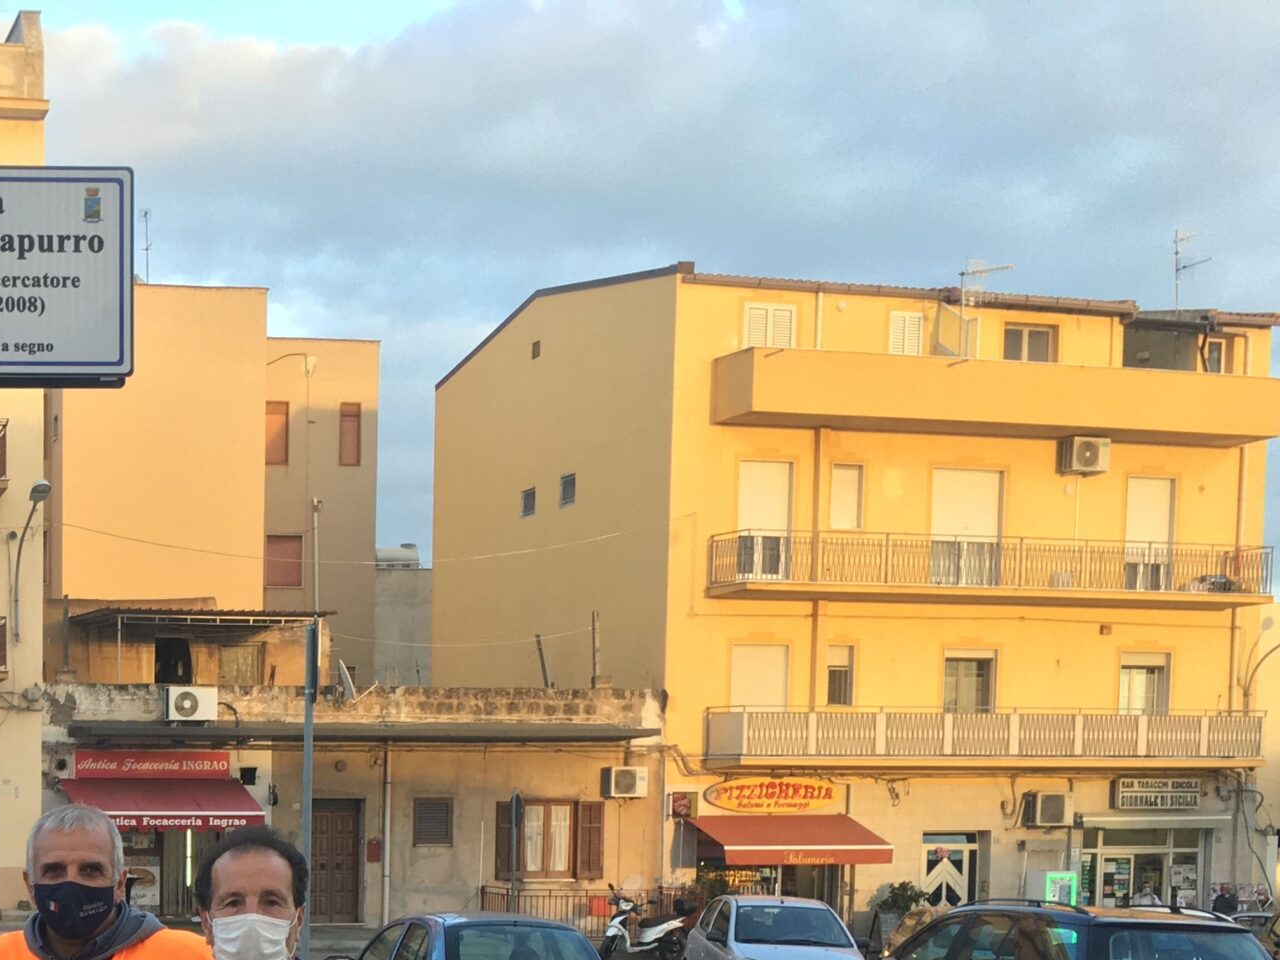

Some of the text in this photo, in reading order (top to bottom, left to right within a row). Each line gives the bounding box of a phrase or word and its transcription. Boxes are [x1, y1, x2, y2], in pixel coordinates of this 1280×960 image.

[1, 343, 9, 352] a
[13, 342, 54, 355] segno
[77, 758, 228, 771] Antica Focacceria INGRAO
[1121, 780, 1198, 789] BAR TABACCHI EDICOLA
[1120, 794, 1198, 807] GIORNALE DI SICILIA
[142, 817, 202, 827] Focacceria
[209, 817, 247, 828] Ingrao
